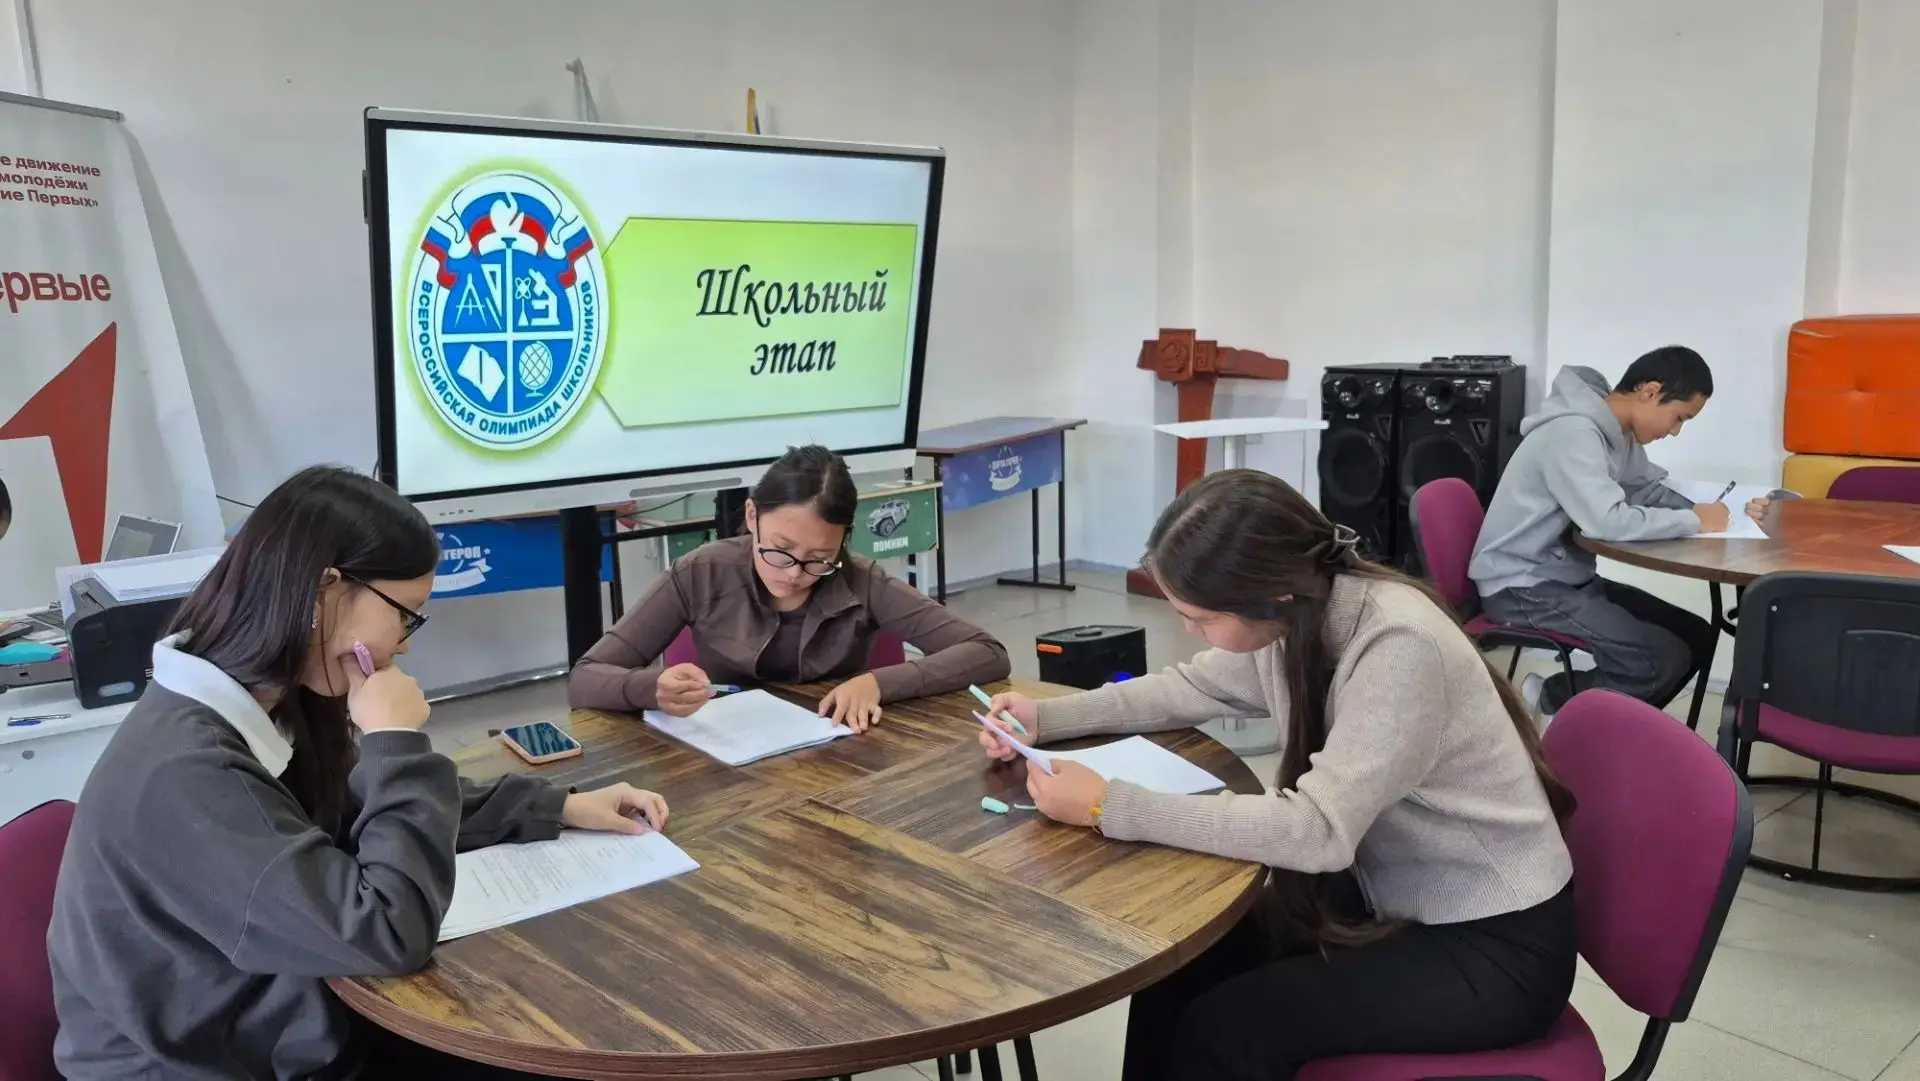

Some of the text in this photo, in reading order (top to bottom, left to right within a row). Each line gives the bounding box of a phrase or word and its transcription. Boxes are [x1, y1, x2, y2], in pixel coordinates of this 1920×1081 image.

[16, 158, 101, 177] движение
[27, 189, 99, 207] Первых»
[0, 272, 112, 313] рвые
[696, 264, 889, 327] Школьный
[418, 280, 594, 435] ВСЕРОССИЙСКАЯ ОЛИМПИАДА ШКОЛЬНИКОВ
[750, 339, 837, 375] этап
